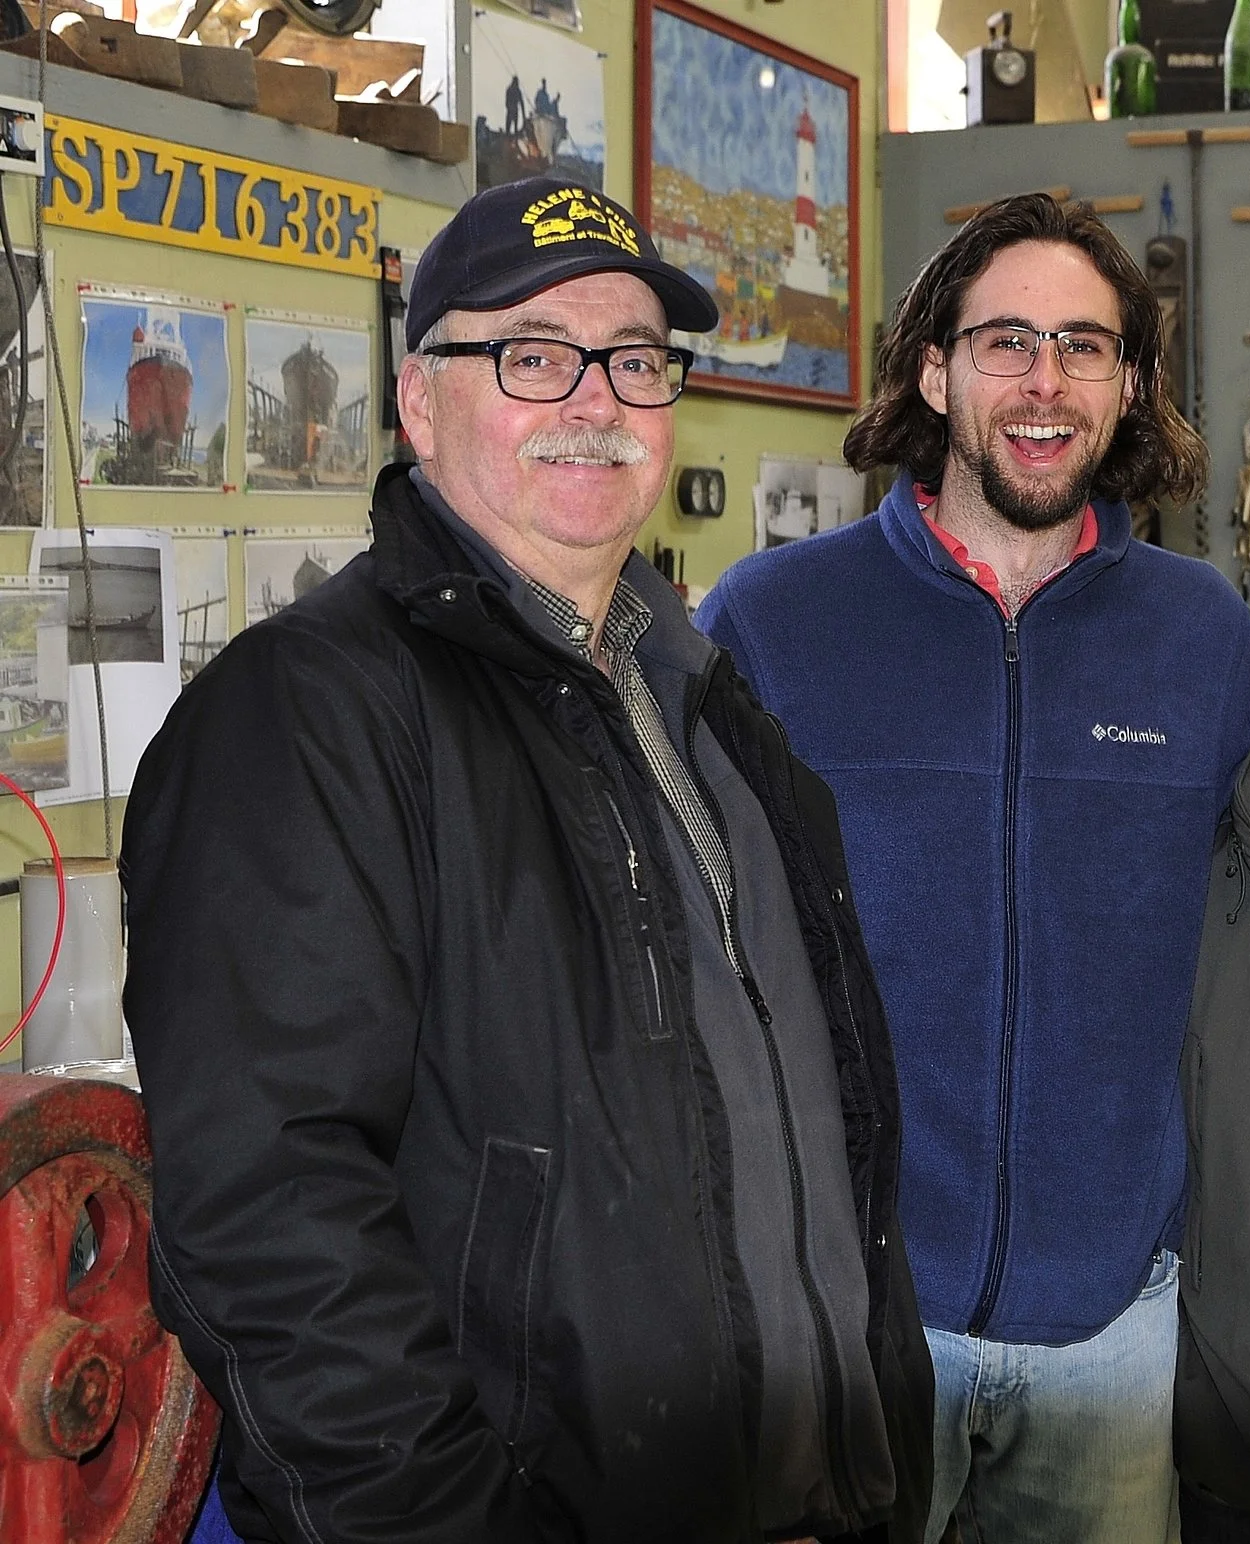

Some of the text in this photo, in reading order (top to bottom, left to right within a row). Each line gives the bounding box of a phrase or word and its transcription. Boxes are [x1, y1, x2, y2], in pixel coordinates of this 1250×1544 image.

[50, 129, 378, 264] SP716383
[521, 188, 586, 225] HELENE
[1106, 725, 1167, 745] Columbia
